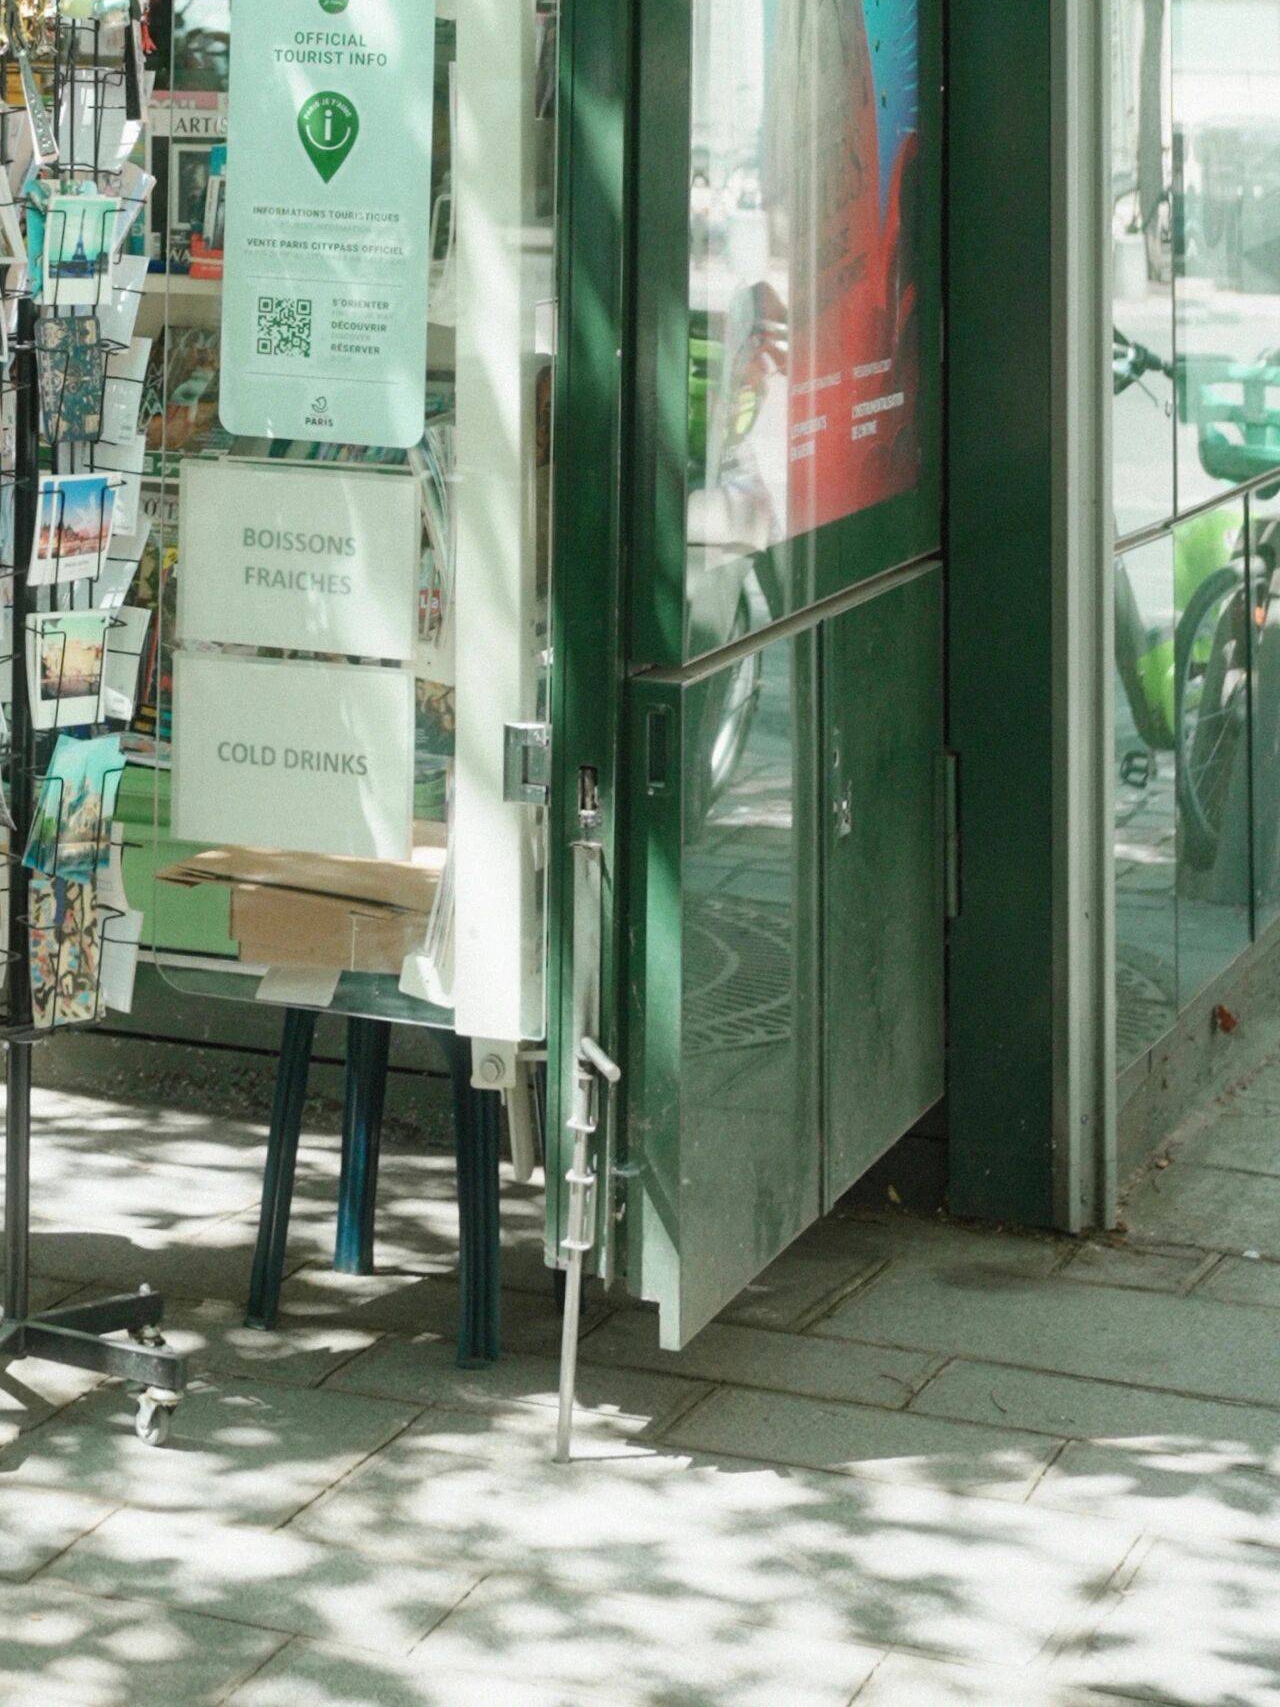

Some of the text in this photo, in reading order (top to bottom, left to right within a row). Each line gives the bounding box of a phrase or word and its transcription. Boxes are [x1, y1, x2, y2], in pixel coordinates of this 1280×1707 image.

[294, 31, 367, 48] OFFICIAL
[274, 49, 389, 67] TOURIST INFO
[252, 206, 400, 223] INFORMATIONS TOURISTIQUES
[246, 237, 404, 255] VENTE PARIS CITYPASS OFFICIEL
[332, 298, 390, 310] S'ORIENTER
[330, 320, 388, 332] DÉCOUVRIR
[330, 342, 381, 355] RÉSERVER
[305, 416, 334, 428] PARIS
[242, 527, 357, 557] BOISSONS
[244, 566, 352, 596] FRAICHES
[217, 741, 369, 776] COLD DRINKS
